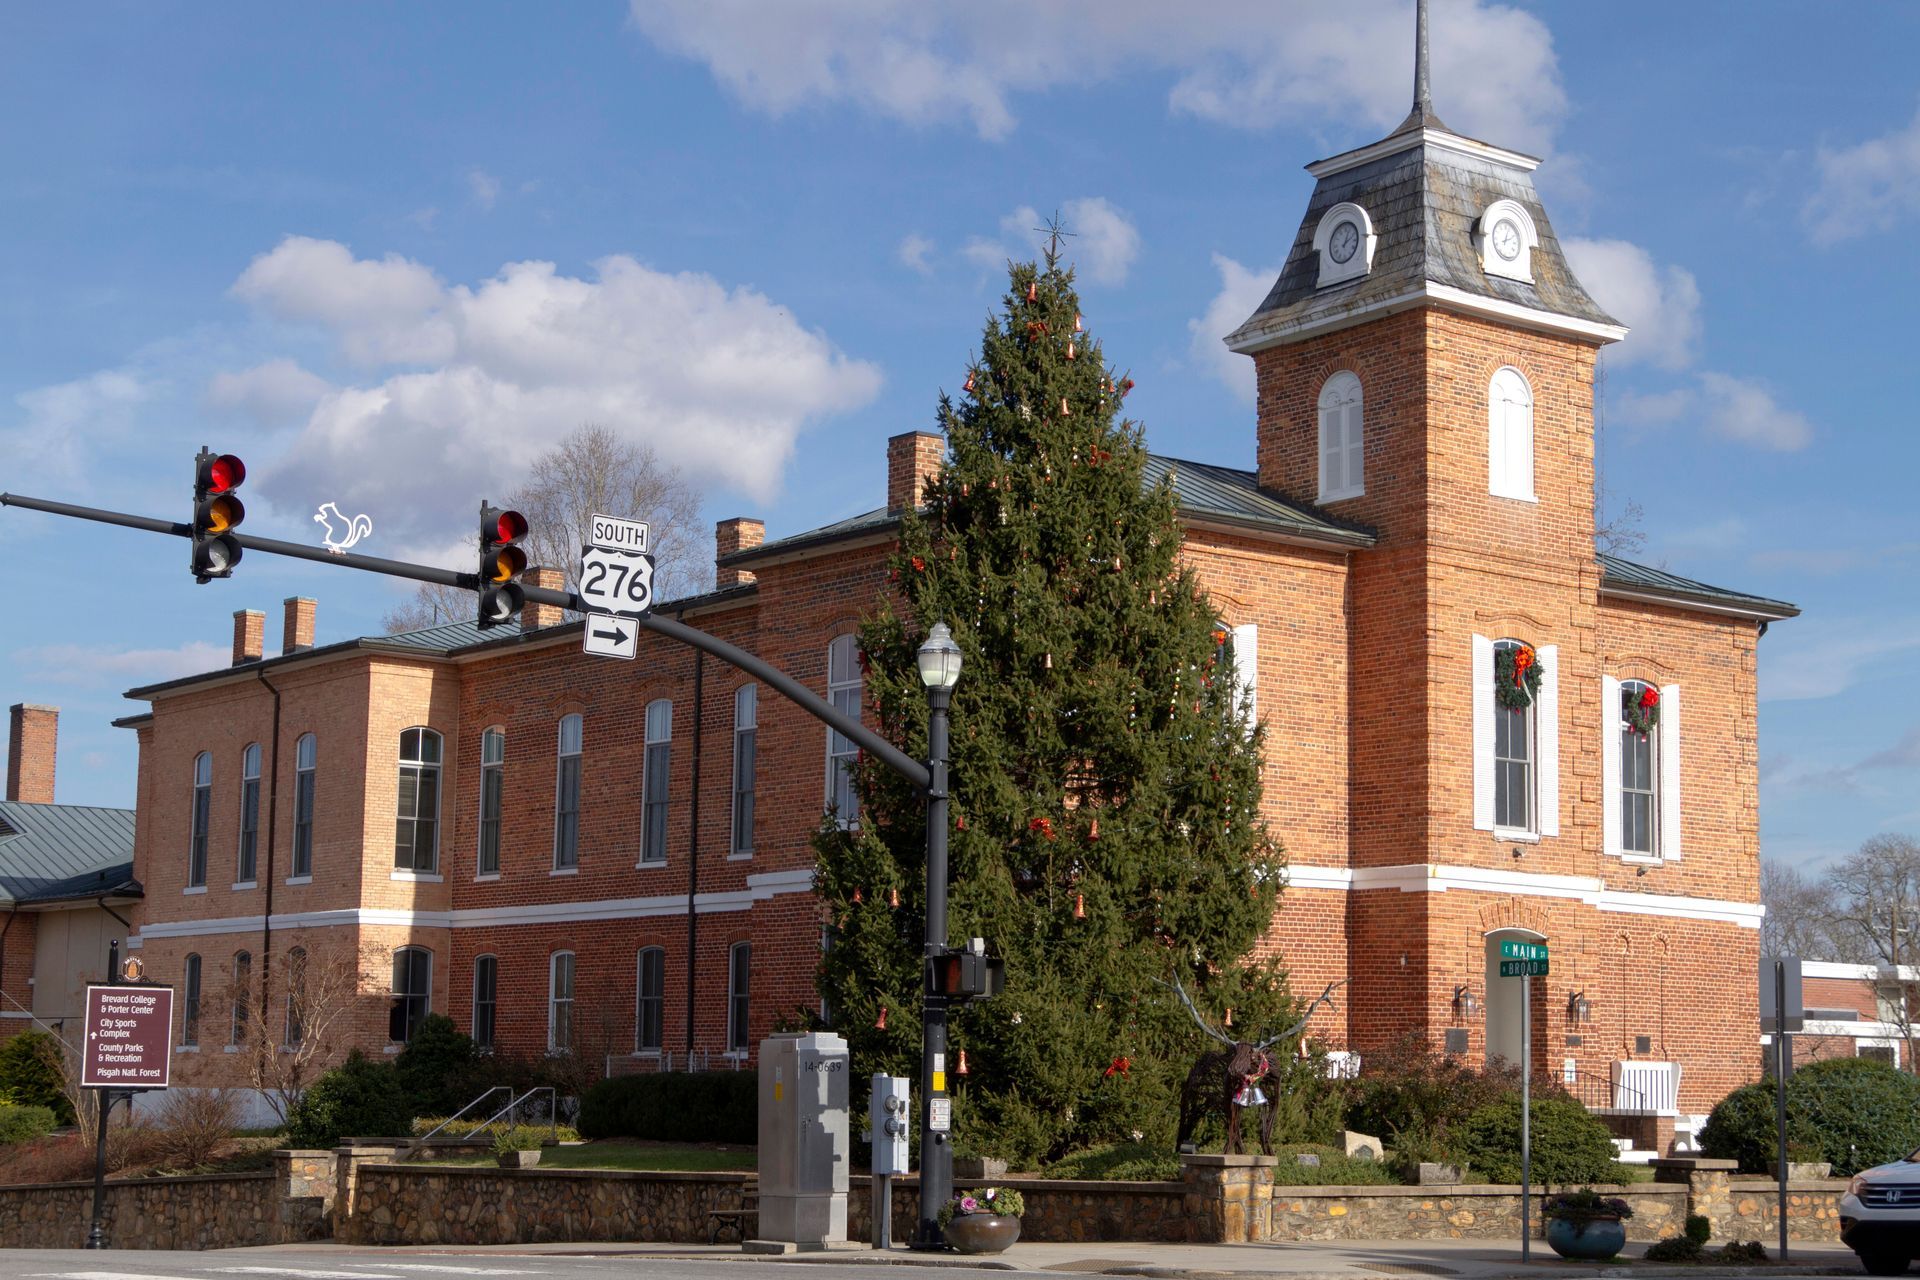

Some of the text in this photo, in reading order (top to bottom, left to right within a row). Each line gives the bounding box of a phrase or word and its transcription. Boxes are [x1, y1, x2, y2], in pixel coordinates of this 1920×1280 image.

[595, 522, 644, 545] SOUTH
[585, 561, 647, 602] 276
[1513, 944, 1536, 959] MAIN
[1509, 962, 1537, 974] BROAD
[102, 995, 156, 1005] Brevard College
[131, 1006, 154, 1014] Center
[100, 1019, 136, 1028] City Sports
[100, 1029, 130, 1039] Complex
[99, 1044, 143, 1053] County Parks
[105, 1054, 142, 1062] Recreation
[804, 1061, 842, 1072] 14-0639
[97, 1068, 120, 1078] Pisgah
[140, 1068, 160, 1077] Forest
